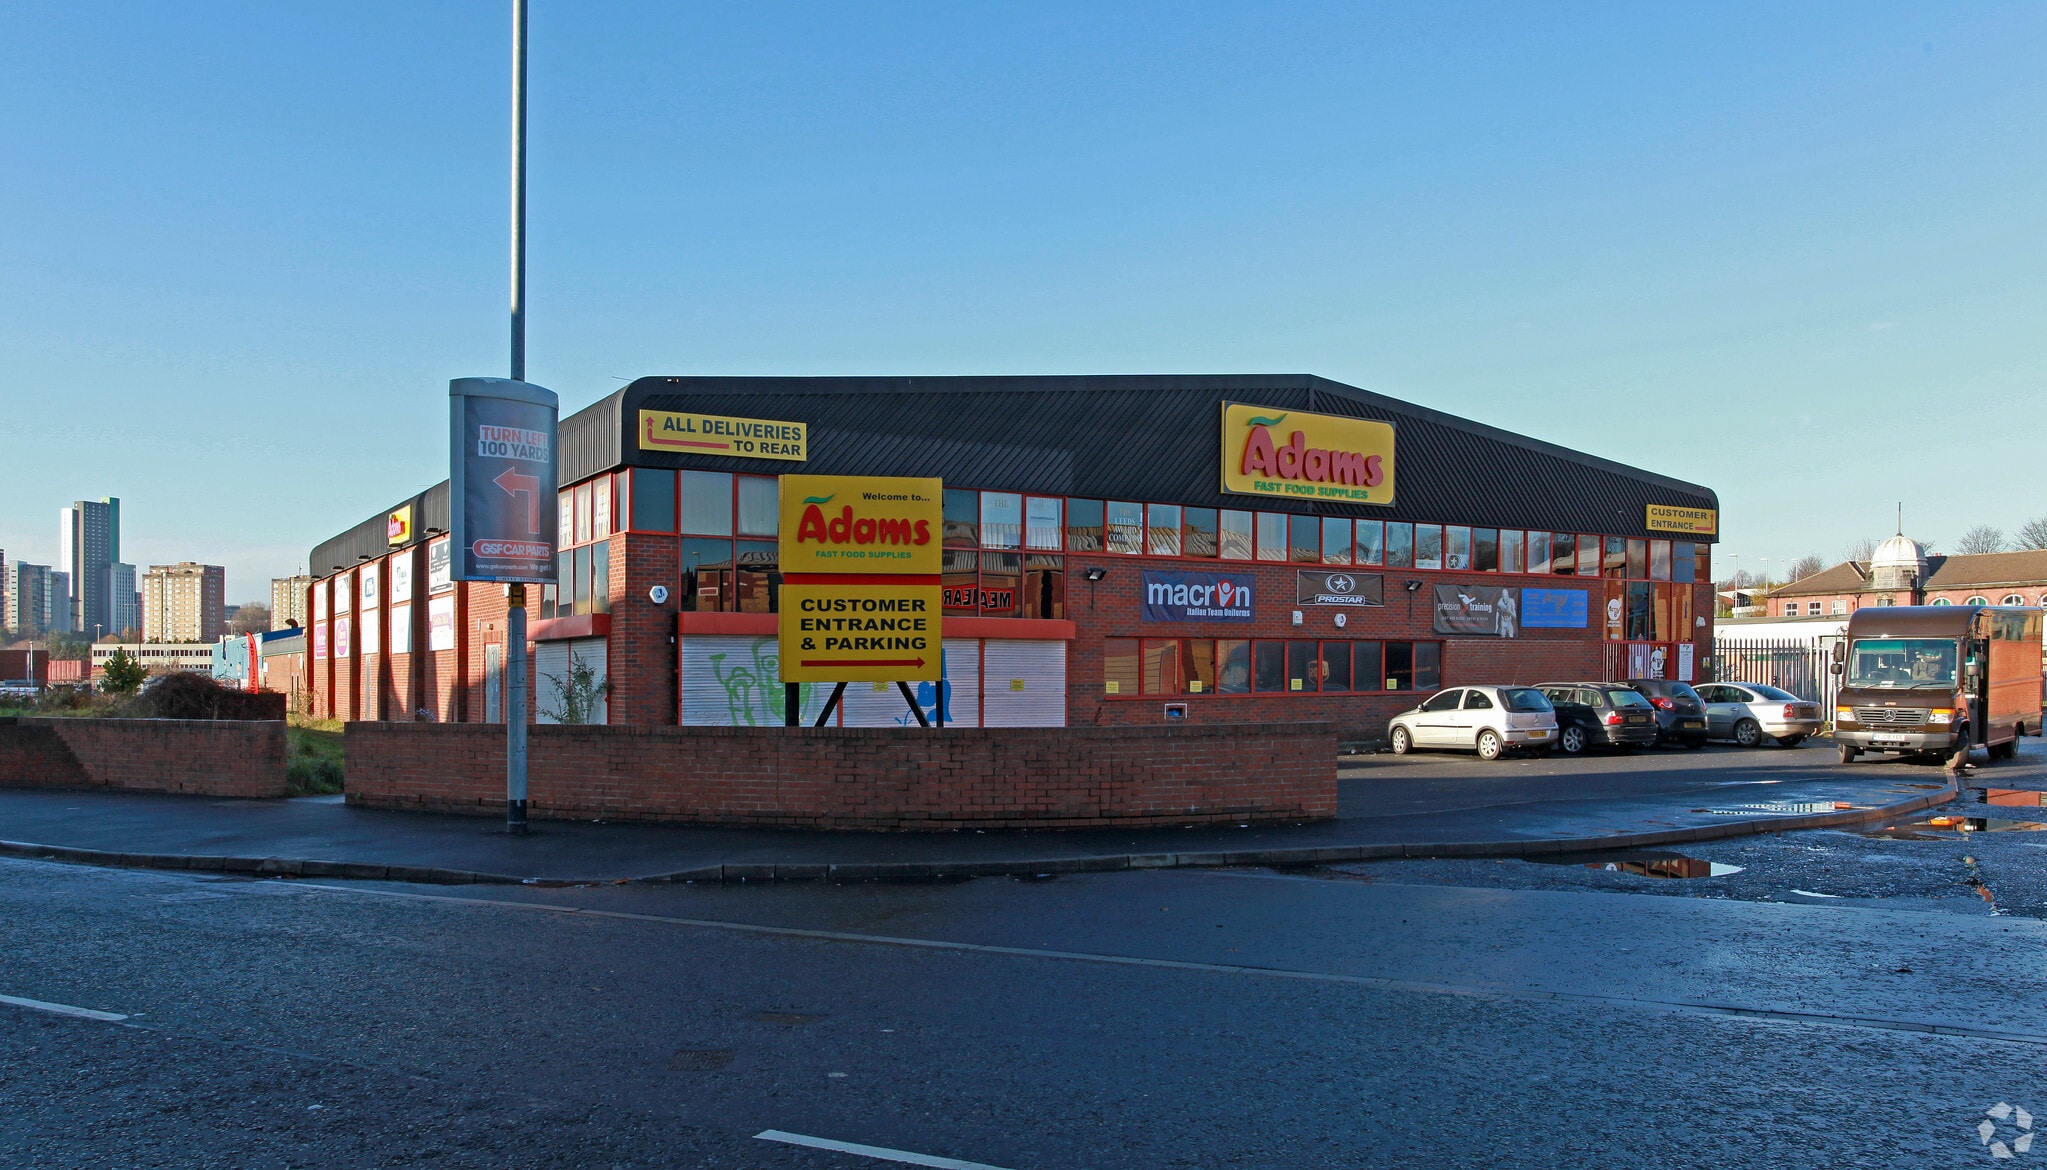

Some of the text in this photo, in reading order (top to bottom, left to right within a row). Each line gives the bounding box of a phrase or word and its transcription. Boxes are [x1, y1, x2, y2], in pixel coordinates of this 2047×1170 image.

[663, 416, 802, 441] ALL DELIVERIES
[481, 426, 547, 446] TURN LEFT
[480, 441, 549, 461] 100 YARDS
[733, 440, 801, 456] TO REAR
[1241, 425, 1384, 487] Adams
[862, 492, 930, 501] Welcome to...
[1254, 481, 1368, 499] FAST FOOD SUPPLIES
[1651, 507, 1707, 520] CUSTOMER
[797, 504, 931, 546] Adams
[1114, 517, 1136, 525] LEEDS
[1651, 519, 1694, 530] ENTRANCE
[480, 543, 550, 557] GSF CAR PARTS
[840, 551, 866, 559] FOOD
[868, 551, 912, 559] SUPPLIES
[800, 598, 926, 612] CUSTOMER
[1317, 595, 1363, 604] PROSTAR
[1186, 607, 1251, 617] Italian Team Uniforms
[1437, 602, 1493, 614] precision training
[800, 618, 927, 631] ENTRANCE
[800, 637, 927, 650] & PARKING
